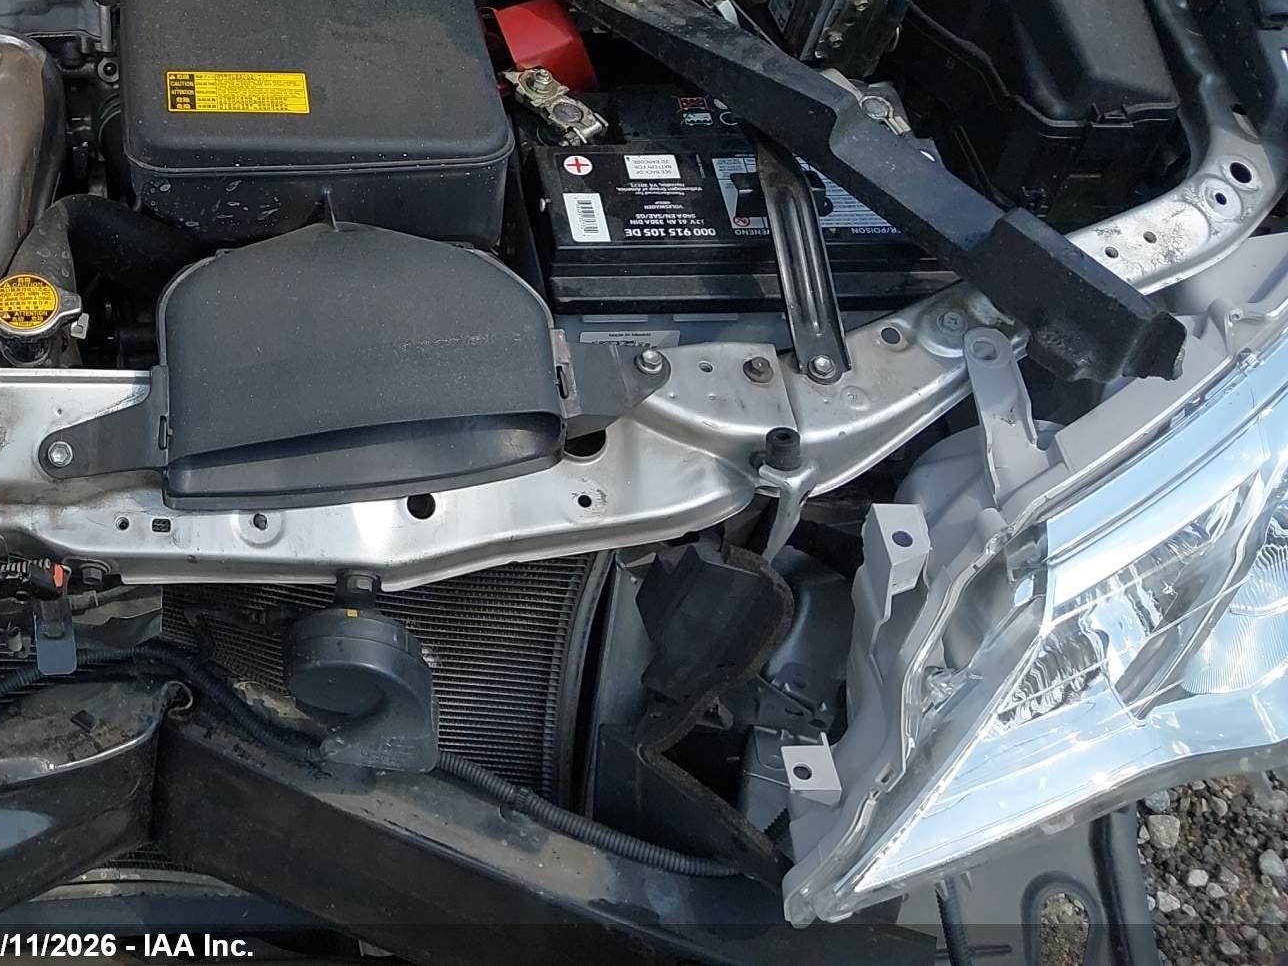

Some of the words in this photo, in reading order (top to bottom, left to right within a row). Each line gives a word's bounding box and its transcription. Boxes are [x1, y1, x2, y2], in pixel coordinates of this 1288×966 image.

[624, 228, 641, 236] DE
[643, 228, 666, 236] 105
[668, 228, 692, 236] 915
[693, 228, 716, 236] 000
